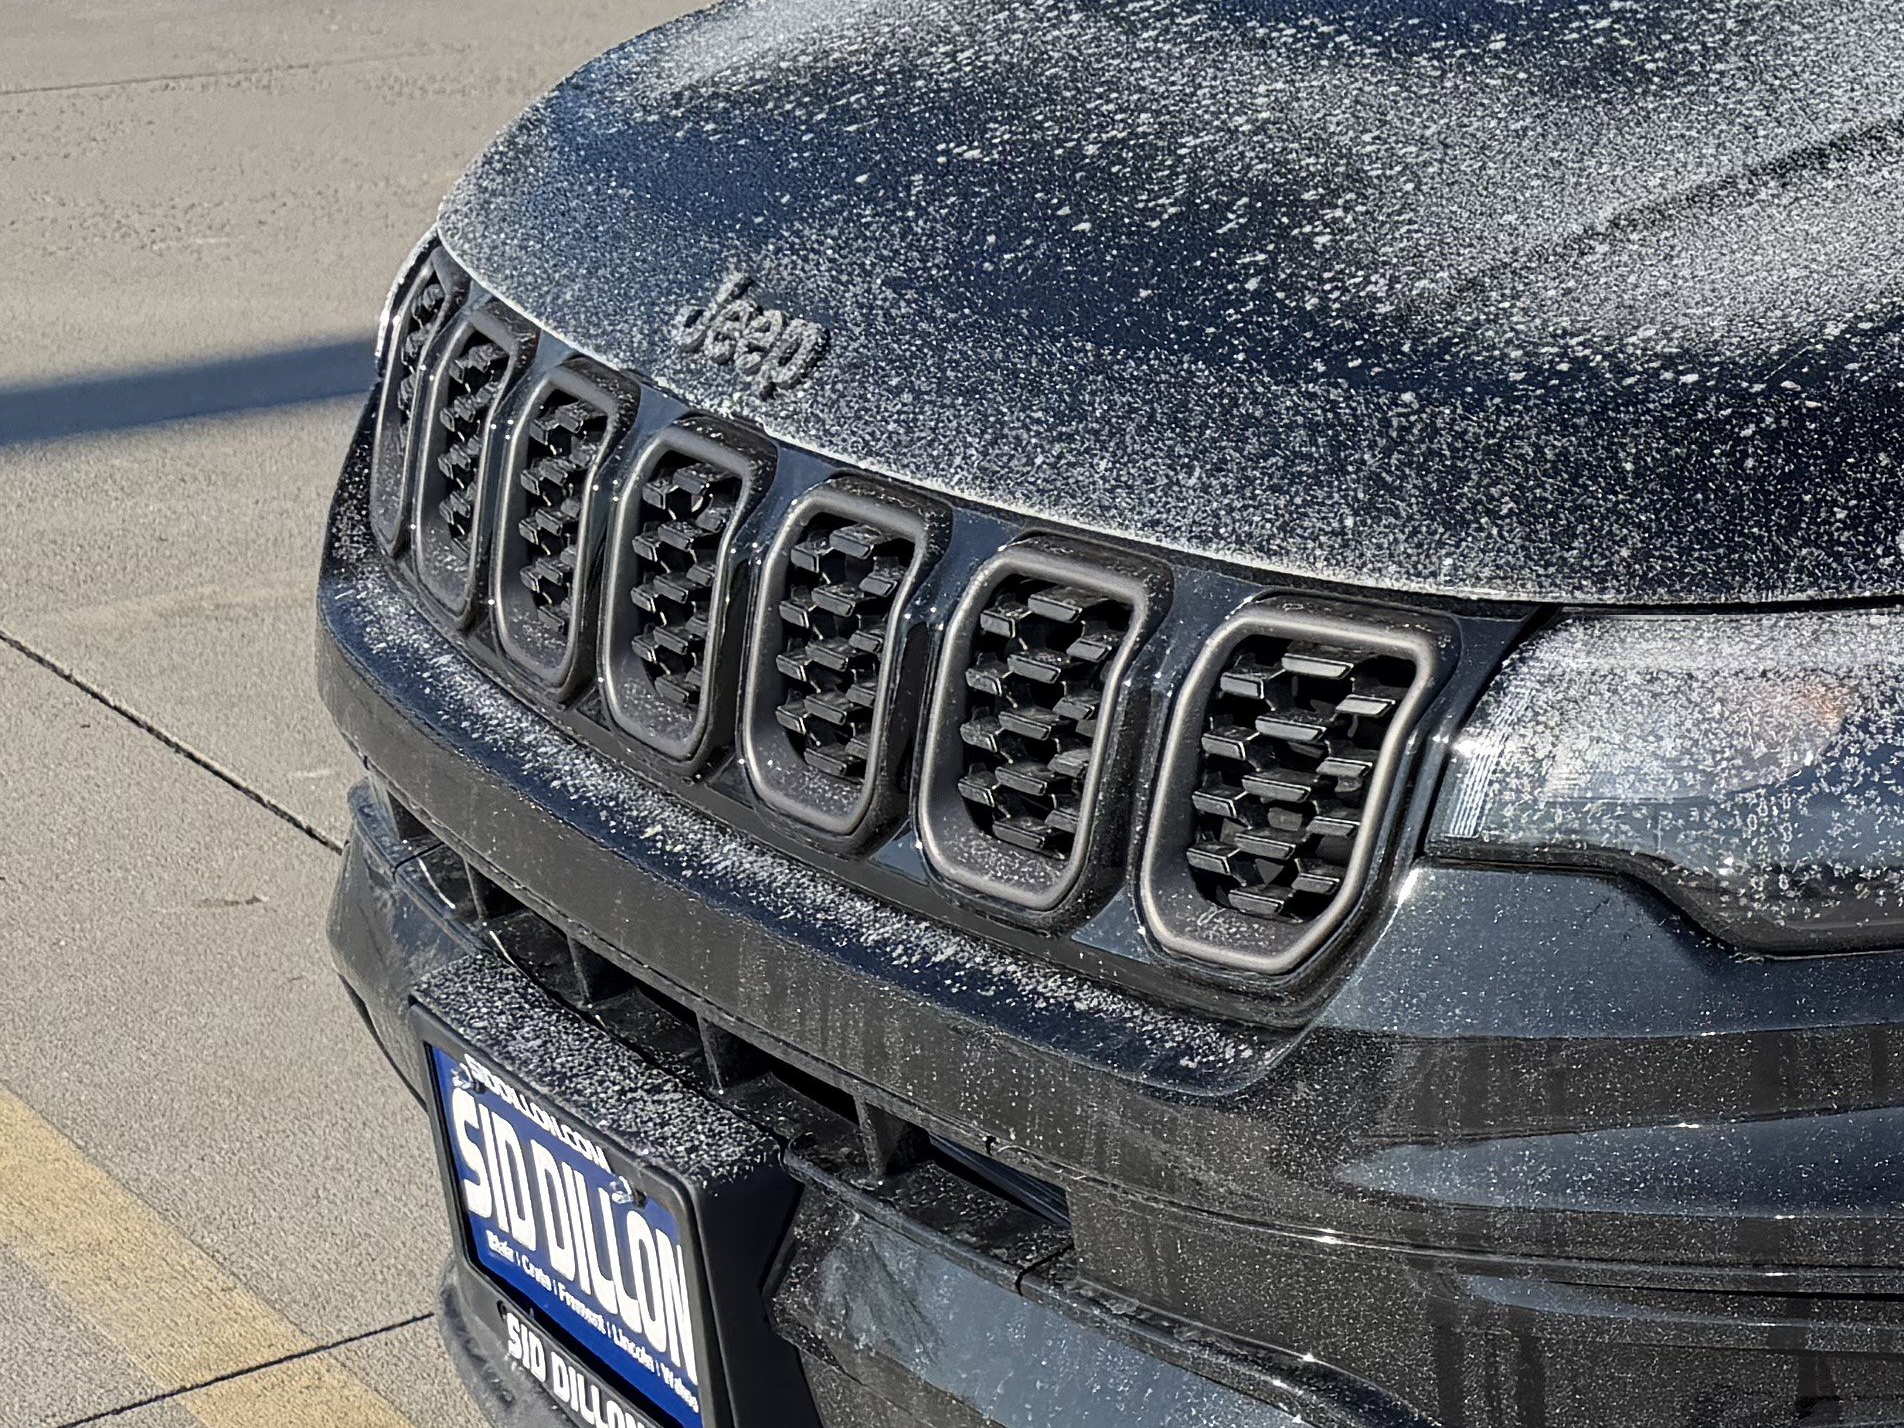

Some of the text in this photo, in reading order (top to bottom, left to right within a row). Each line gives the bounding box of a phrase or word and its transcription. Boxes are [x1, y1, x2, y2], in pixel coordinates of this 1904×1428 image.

[670, 270, 831, 400] Jeep
[452, 1086, 699, 1388] SID DILLON
[506, 1311, 547, 1383] SID
